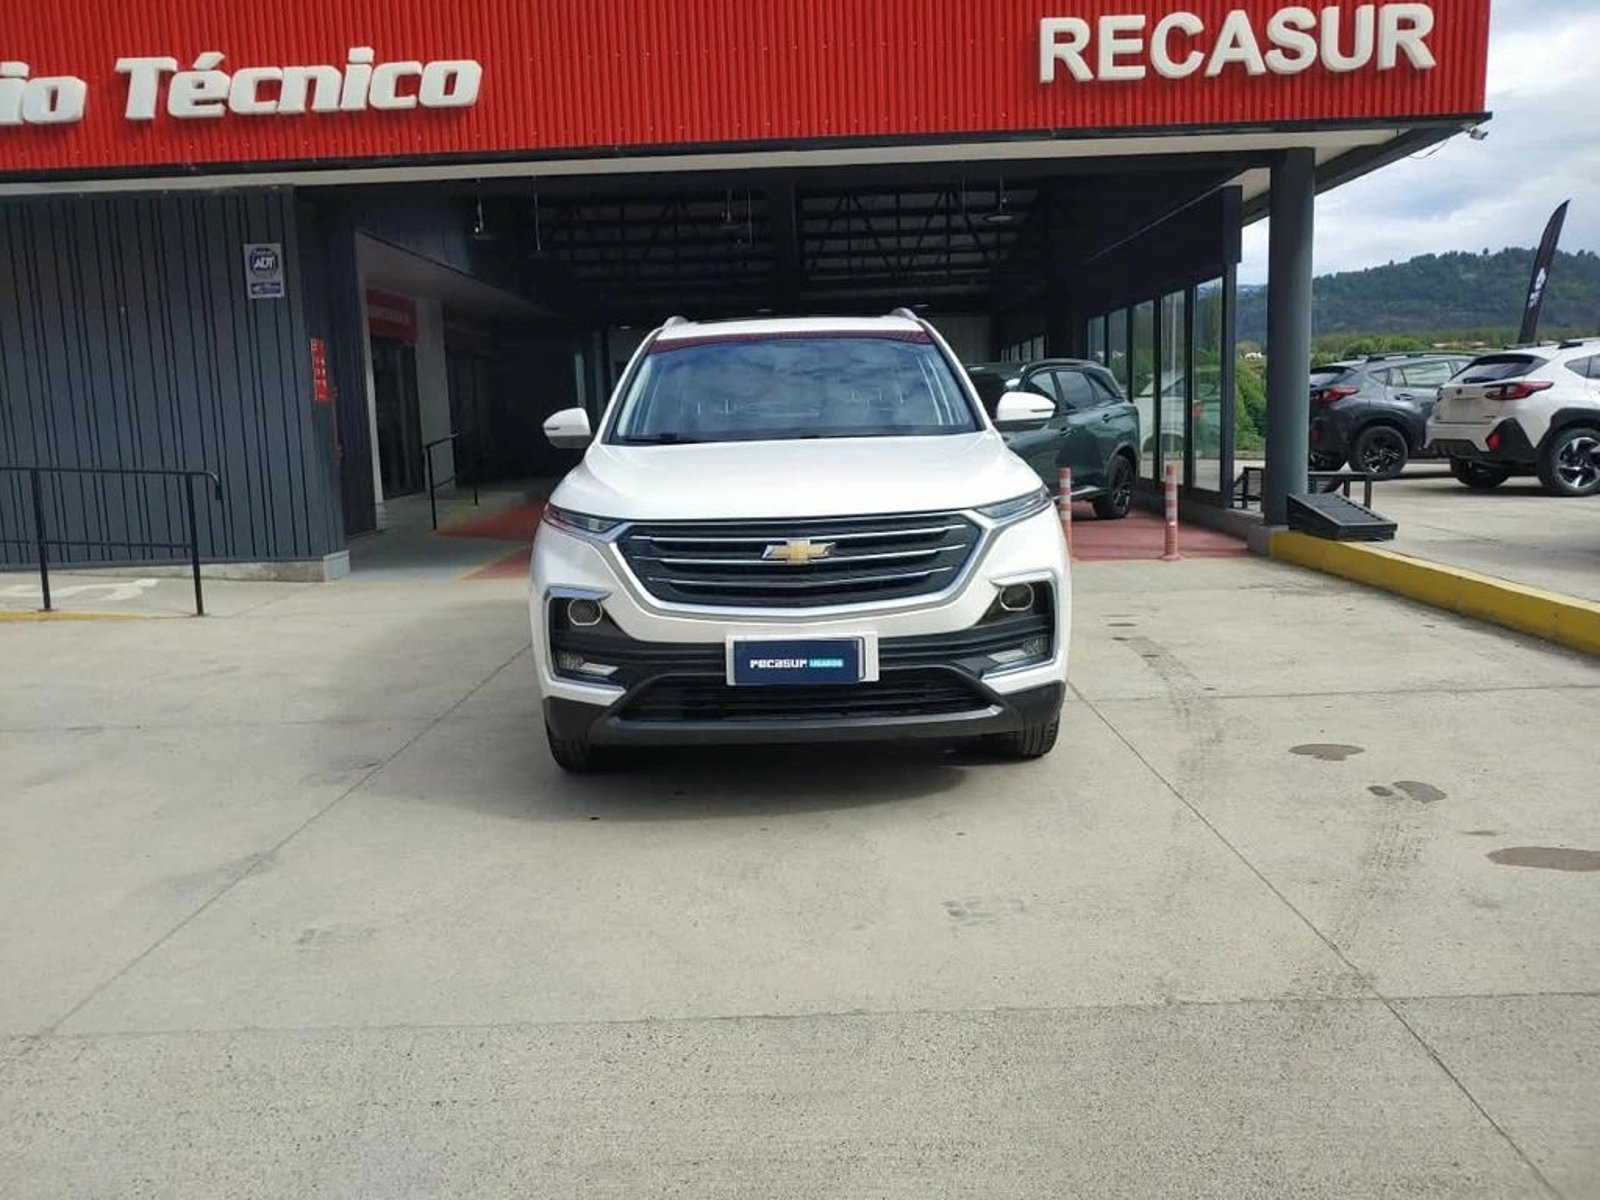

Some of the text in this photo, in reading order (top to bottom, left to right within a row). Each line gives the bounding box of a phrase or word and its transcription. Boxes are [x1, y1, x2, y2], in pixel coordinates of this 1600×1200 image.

[1039, 3, 1437, 83] RECASUR
[115, 46, 483, 120] Técnico
[253, 257, 275, 269] ADT
